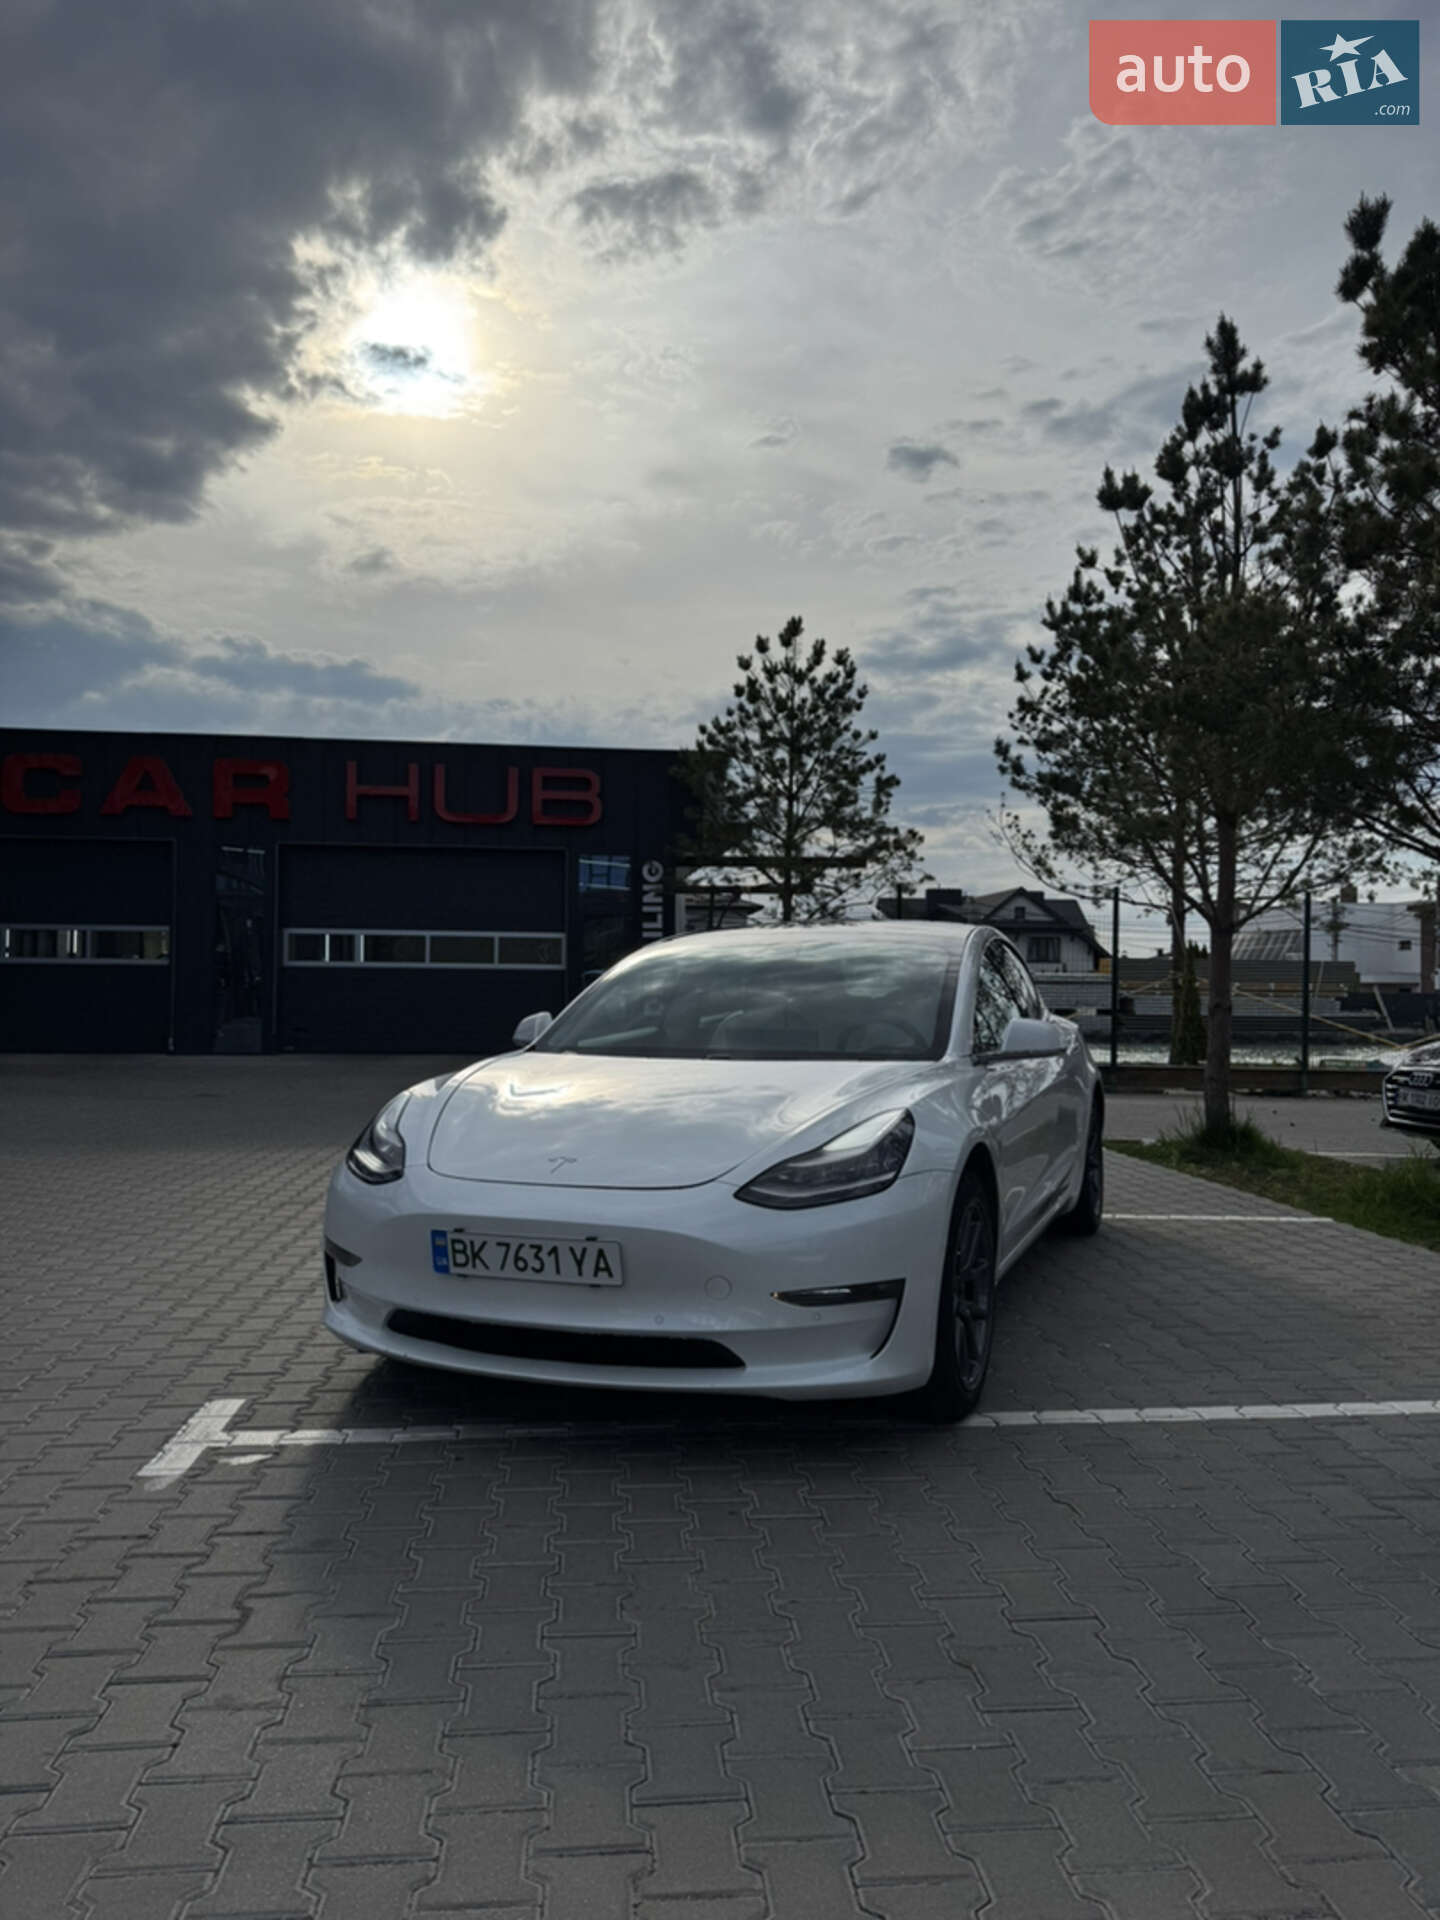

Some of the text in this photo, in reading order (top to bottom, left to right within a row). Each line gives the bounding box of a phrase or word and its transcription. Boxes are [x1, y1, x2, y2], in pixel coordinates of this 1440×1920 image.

[2, 754, 602, 826] CAR HUB
[641, 860, 664, 938] ILING
[450, 1239, 614, 1278] BK 7631 YA
